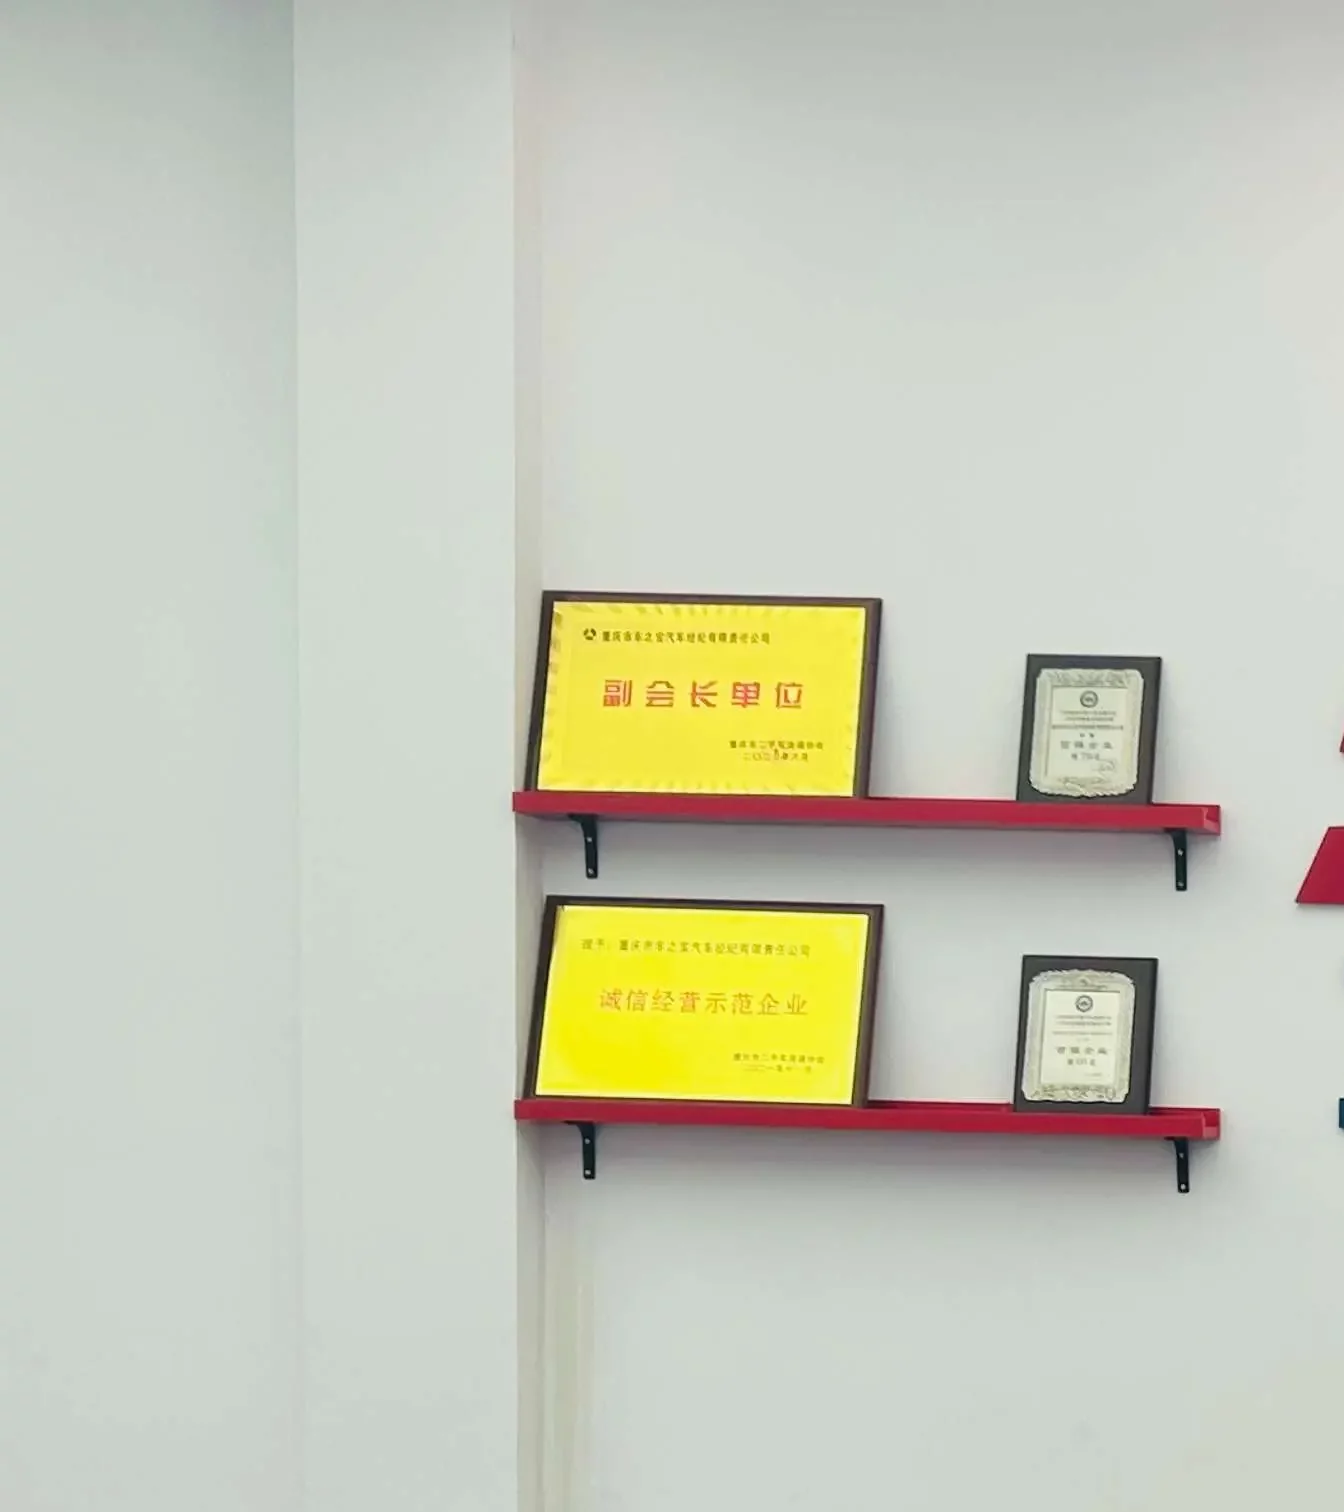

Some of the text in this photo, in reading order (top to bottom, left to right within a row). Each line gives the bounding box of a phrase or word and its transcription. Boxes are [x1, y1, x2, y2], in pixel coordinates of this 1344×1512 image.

[602, 679, 804, 709] 副会长单位
[600, 987, 809, 1016] 诚信经营示范企业
